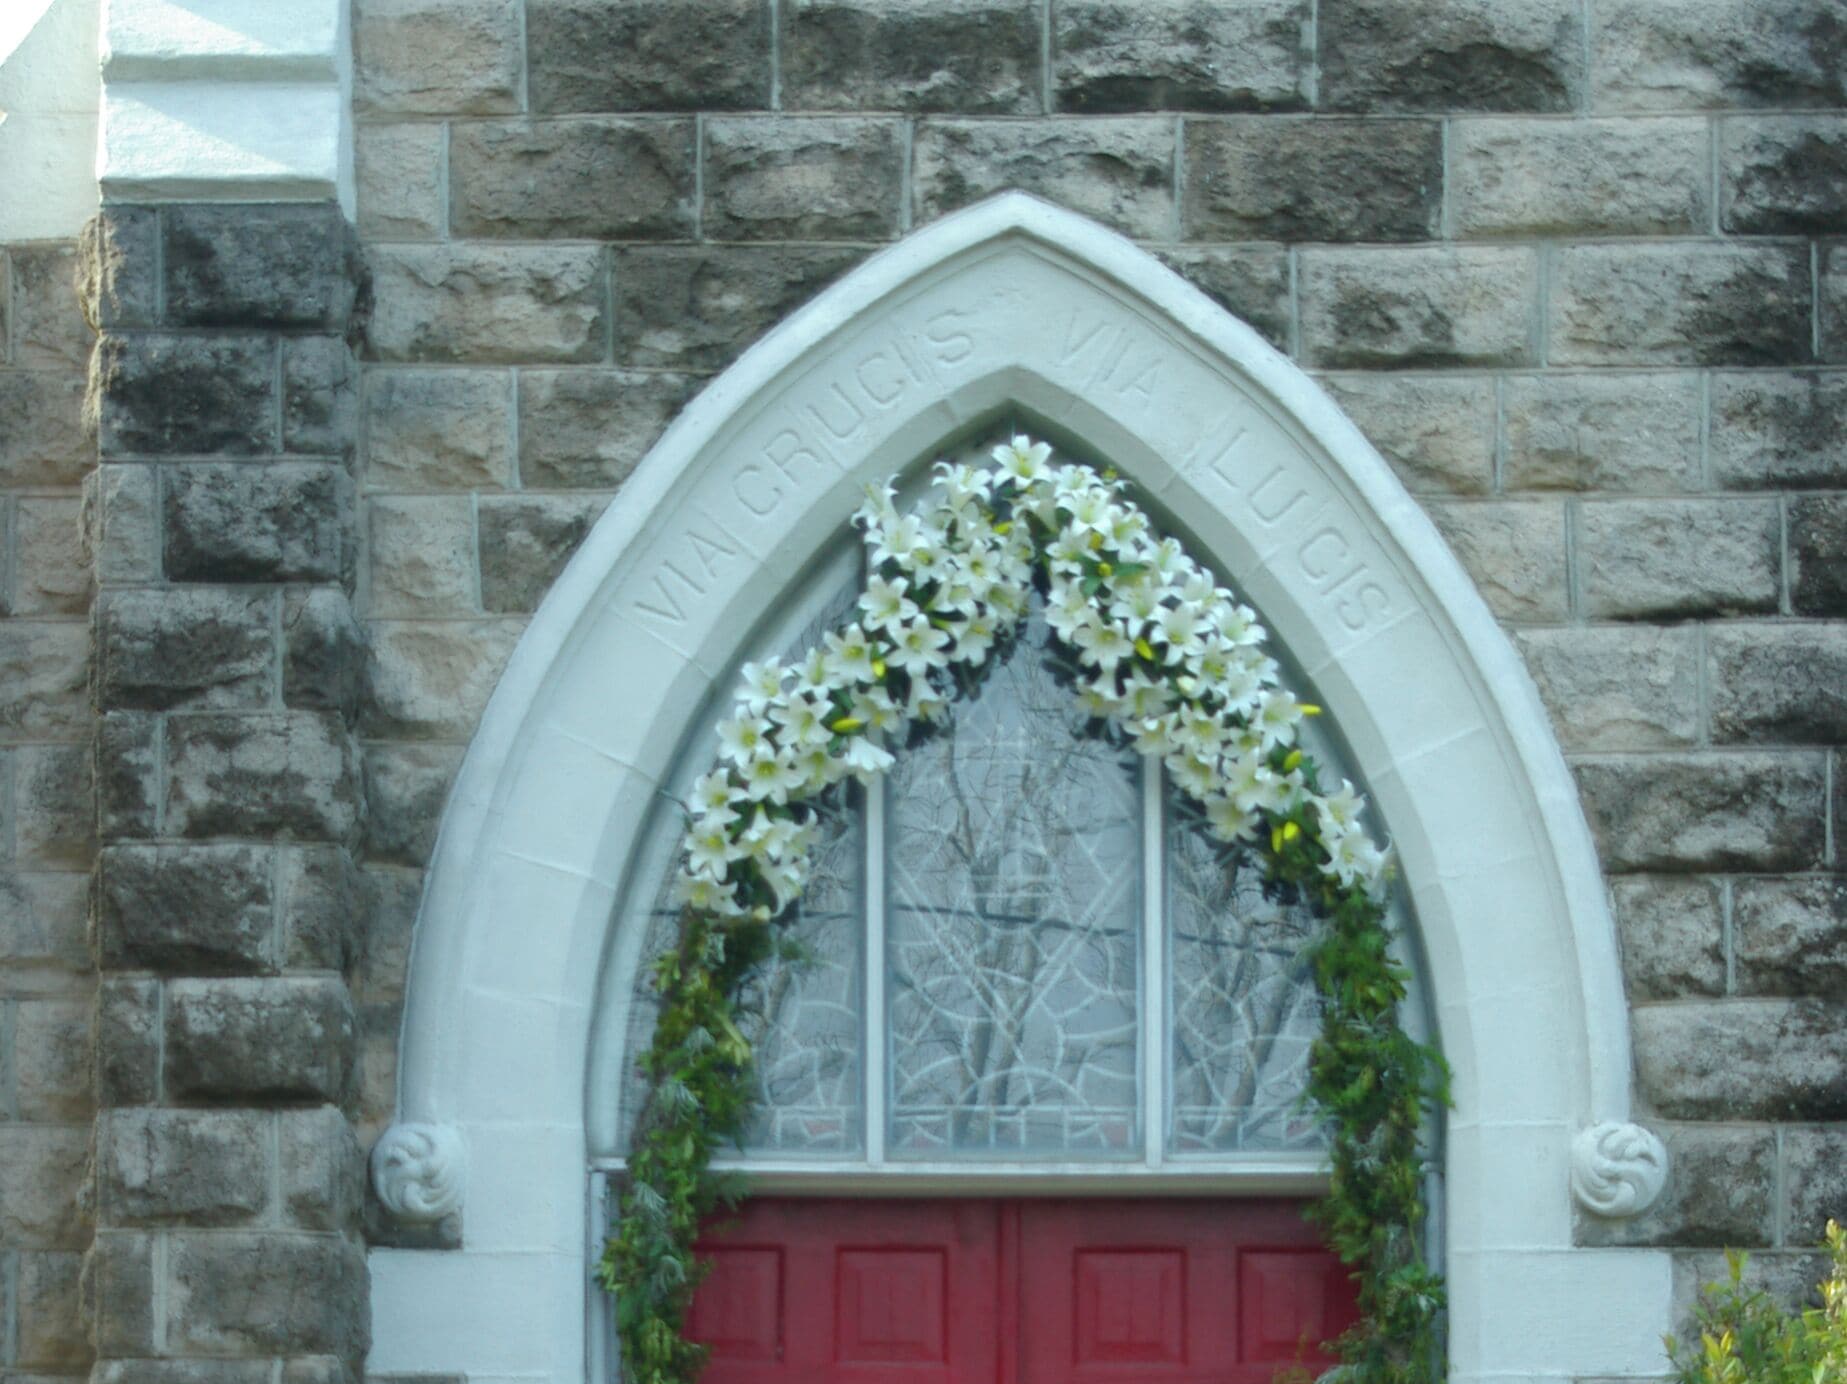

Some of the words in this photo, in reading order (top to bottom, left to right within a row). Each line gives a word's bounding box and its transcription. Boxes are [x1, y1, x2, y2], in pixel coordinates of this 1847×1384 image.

[633, 530, 737, 623] VIA
[732, 308, 975, 518] CRUCIS
[1060, 312, 1166, 404] VIA
[1208, 425, 1391, 632] LUCIS
